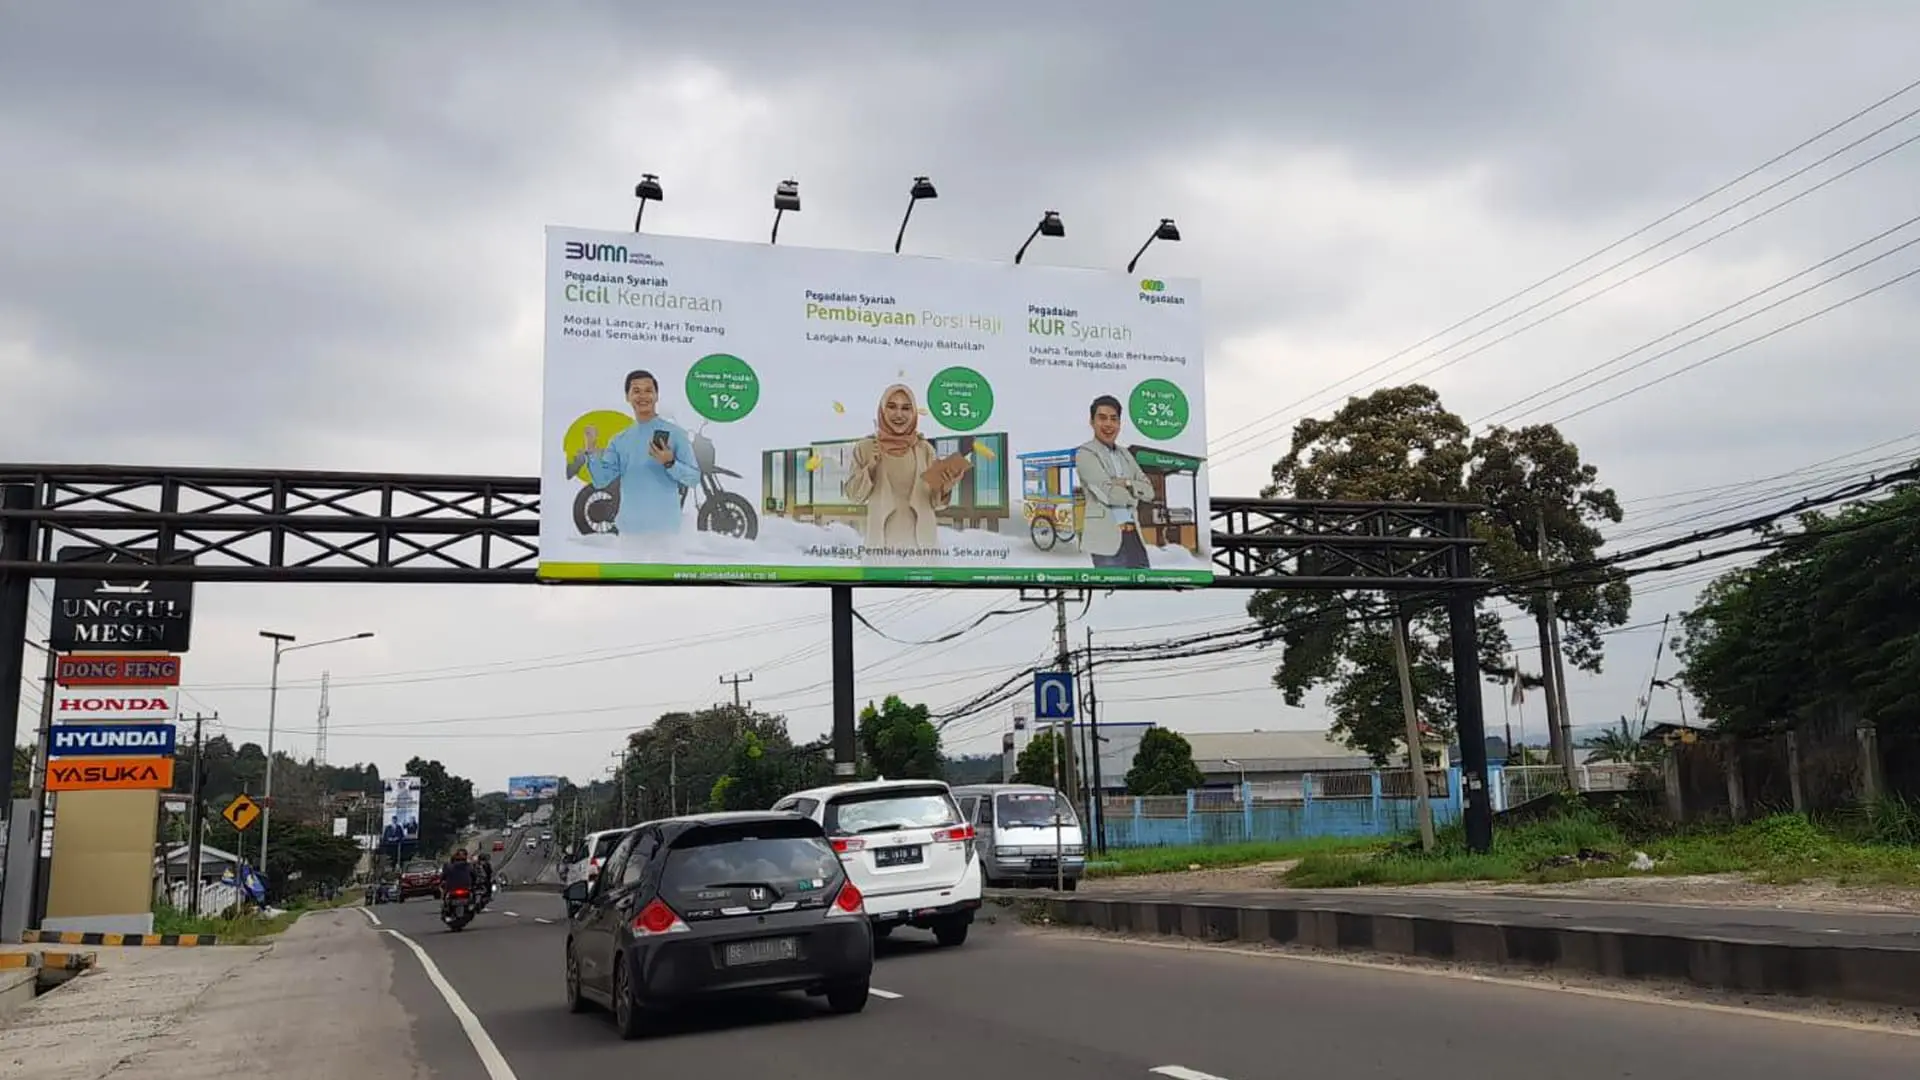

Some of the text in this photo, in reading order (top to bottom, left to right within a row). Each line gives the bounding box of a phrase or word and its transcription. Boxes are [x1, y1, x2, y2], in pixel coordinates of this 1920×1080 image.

[565, 242, 627, 263] BUMN
[565, 270, 668, 287] Pegadaian Syariah
[565, 284, 722, 312] Cicil Kendaraan
[805, 289, 896, 306] Pegadaian Syariah
[1139, 292, 1185, 305] Pegadaian
[806, 303, 1003, 335] Pembiayaan Porsi Haji
[1028, 305, 1078, 318] Pegadaian
[563, 314, 725, 336] Modal Lancar, Hari Tenang
[1028, 319, 1132, 342] KUR Syariah
[563, 327, 694, 344] Modal Semakin Besar
[806, 332, 985, 351] Langkah Mulia, Menuju Baitullah
[1029, 345, 1187, 365] Usaha Tumbuh dan Berkembang
[1029, 357, 1127, 371] Bersama Pegadaian
[710, 394, 739, 410] 1%
[1147, 402, 1174, 417] 3%
[811, 544, 1010, 560] Ajukan Pembiayaanmu Sekarang!
[63, 599, 183, 619] UNGGUL
[74, 623, 165, 642] MESIN
[62, 662, 177, 678] DONG FENG
[59, 699, 169, 711] HONDA
[55, 731, 167, 748] HYUNDAI
[52, 767, 159, 783] YASUKA
